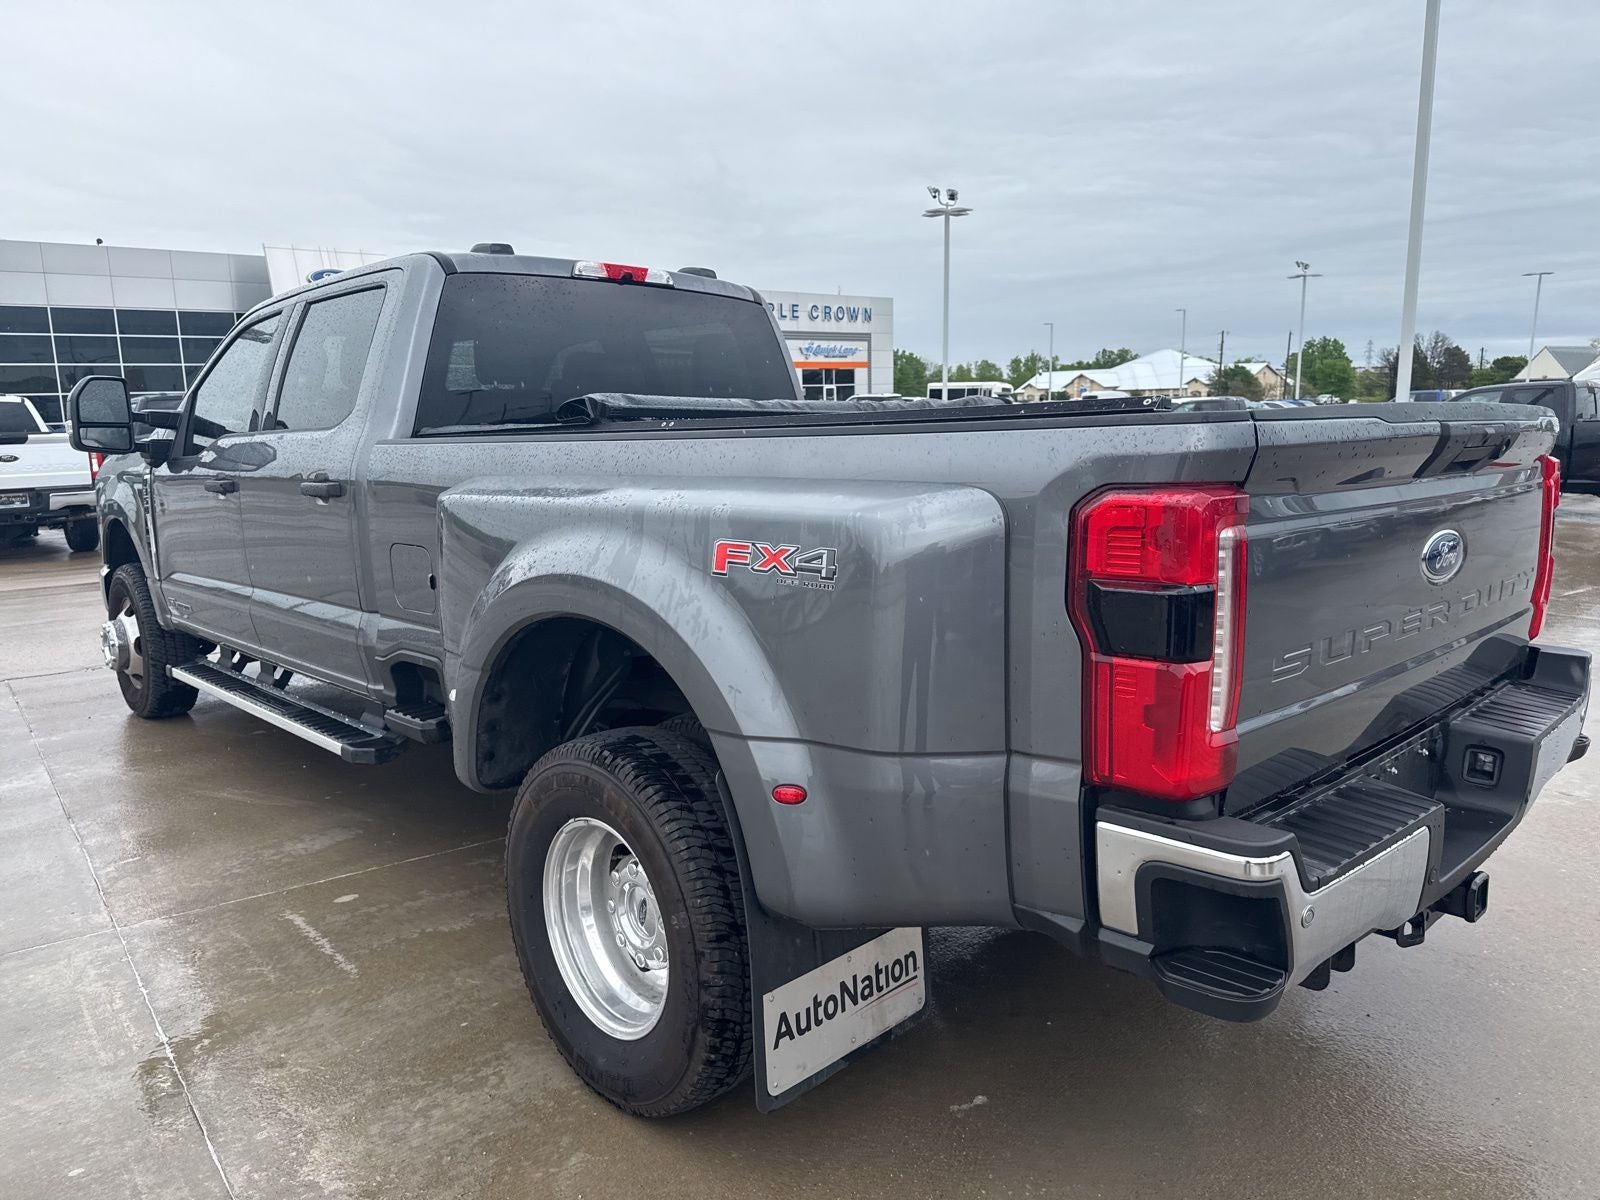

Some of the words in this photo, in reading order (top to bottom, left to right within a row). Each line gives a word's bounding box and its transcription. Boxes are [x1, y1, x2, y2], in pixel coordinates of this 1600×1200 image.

[809, 304, 872, 322] CROWN
[711, 538, 838, 582] FX4
[803, 580, 836, 591] ROAD
[1271, 600, 1451, 683] SUPER
[1459, 567, 1535, 617] DUTY
[773, 950, 919, 1051] AutoNation
